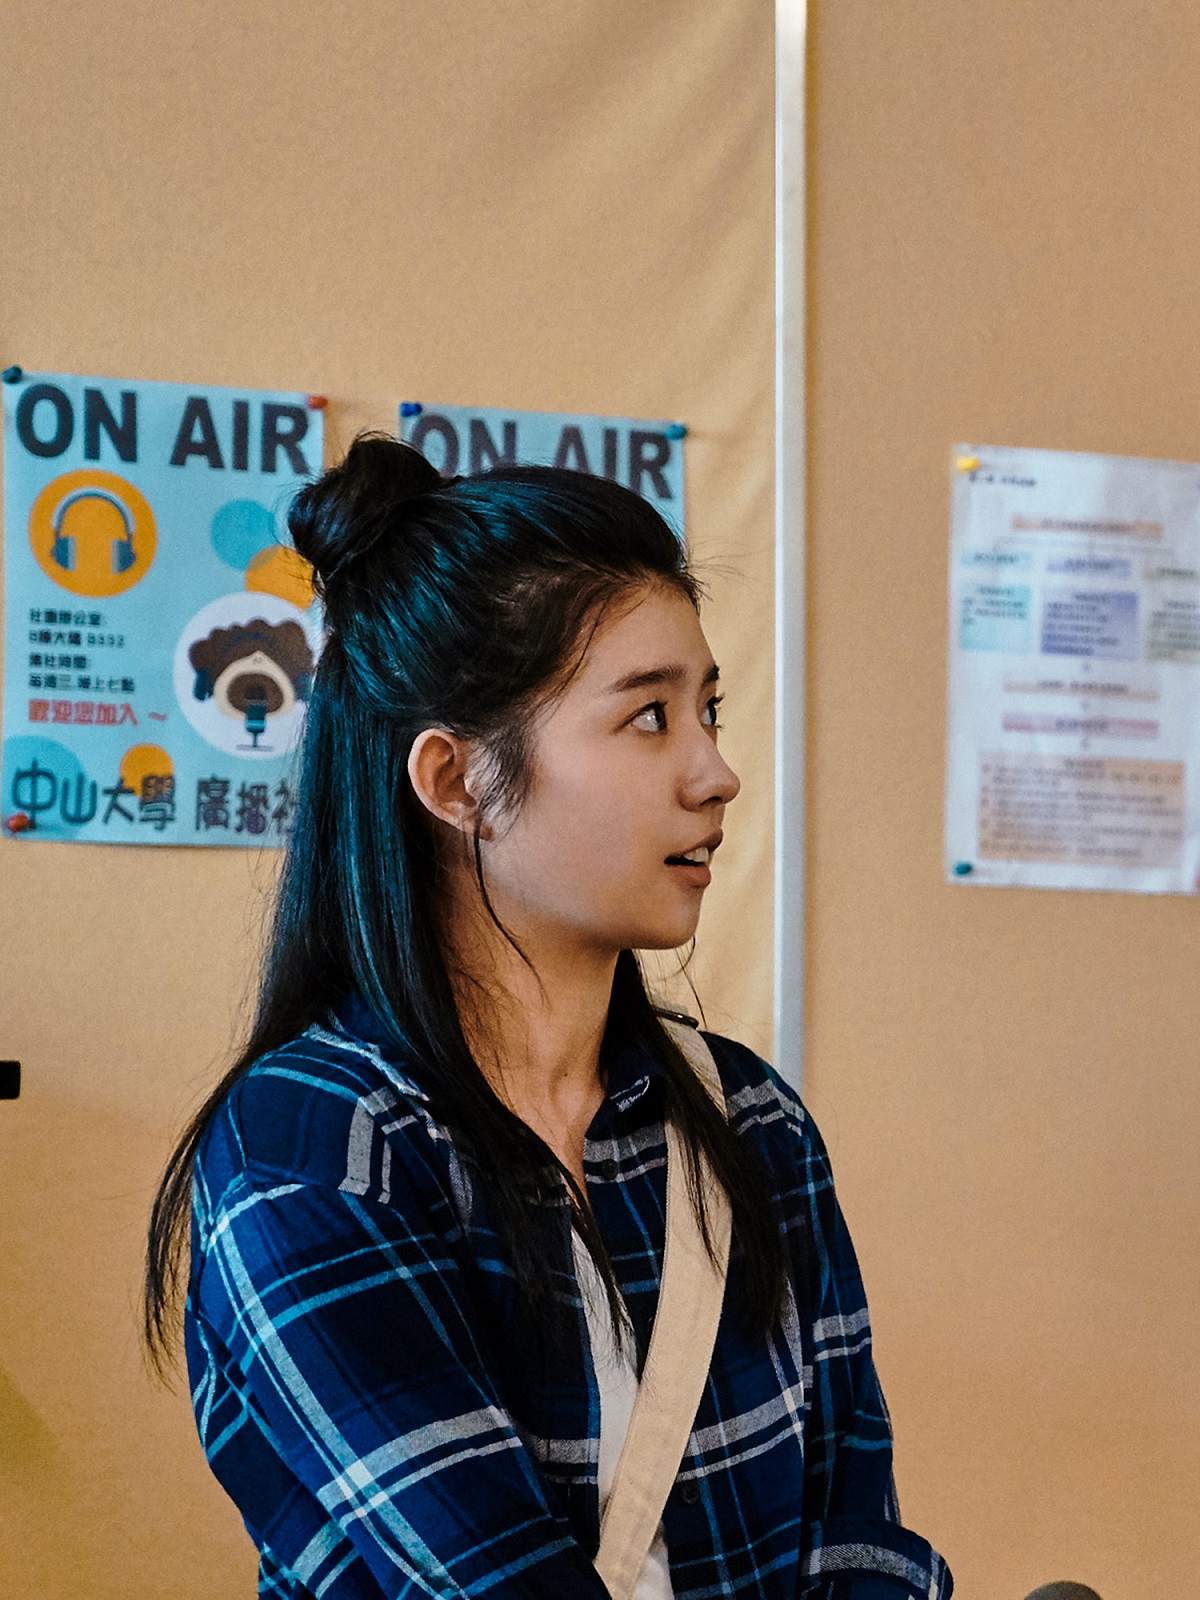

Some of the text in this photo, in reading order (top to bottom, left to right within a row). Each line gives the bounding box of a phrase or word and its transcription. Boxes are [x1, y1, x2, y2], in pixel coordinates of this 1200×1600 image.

[16, 383, 310, 475] ON AIR
[11, 757, 176, 831] 中山大學
